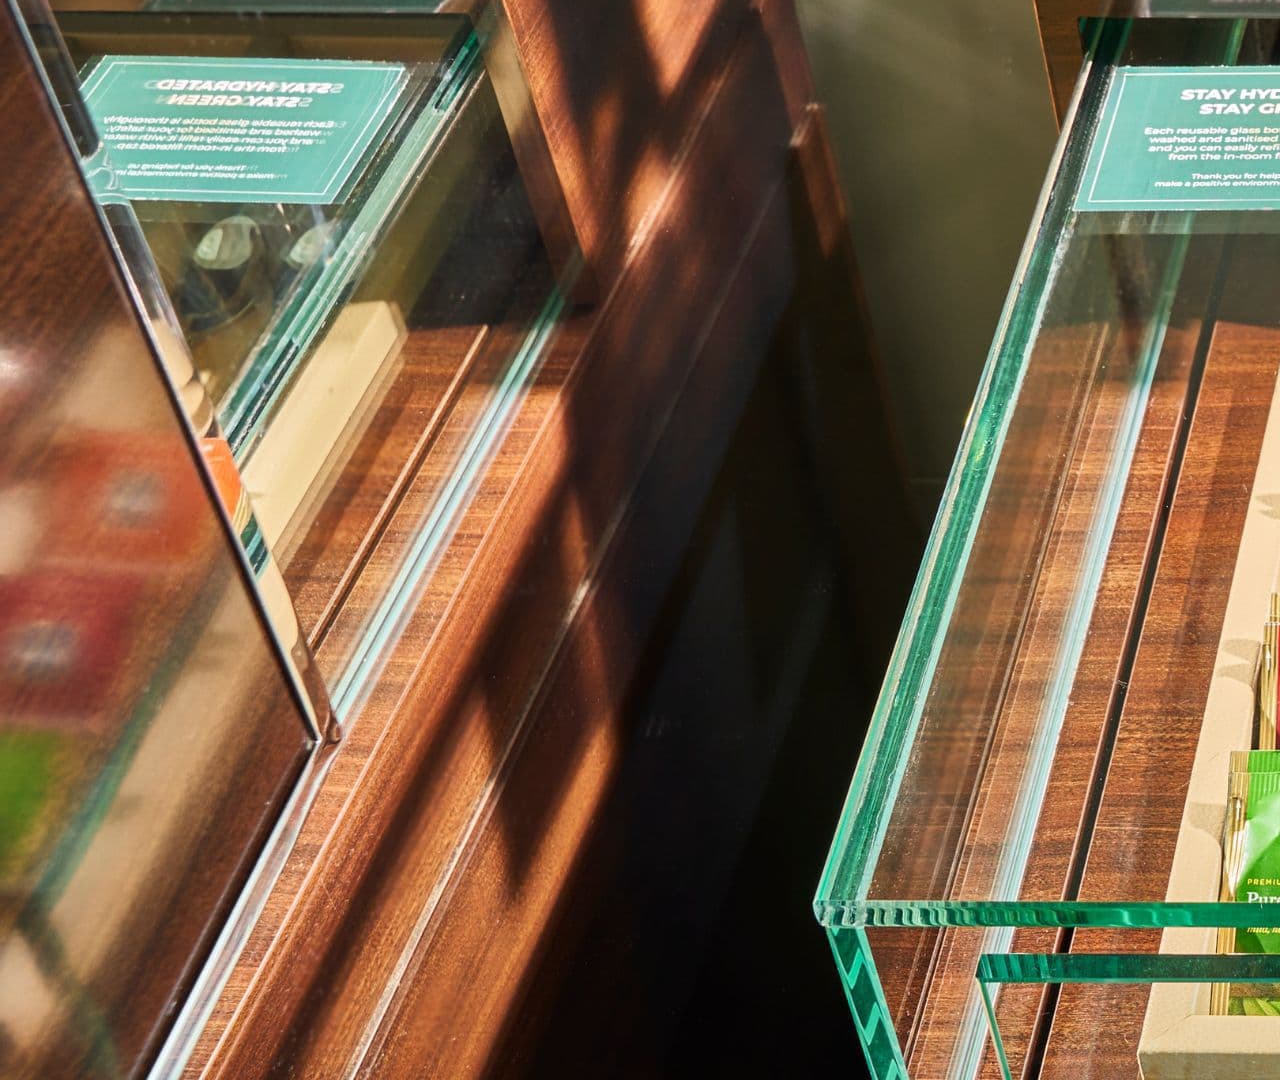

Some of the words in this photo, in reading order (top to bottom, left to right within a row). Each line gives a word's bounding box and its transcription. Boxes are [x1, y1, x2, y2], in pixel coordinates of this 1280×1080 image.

[1180, 88, 1237, 101] STAY
[1199, 103, 1255, 114] STAY
[1144, 127, 1174, 135] Each
[1230, 126, 1261, 135] glass
[1149, 135, 1196, 143] washed
[1198, 135, 1222, 143] and
[1224, 135, 1279, 143] sanitised
[1148, 144, 1173, 152] and
[1173, 145, 1197, 153] you
[1224, 144, 1258, 152] easily
[1168, 153, 1197, 161] from
[1223, 152, 1272, 160] in-room
[1192, 180, 1231, 188] positive
